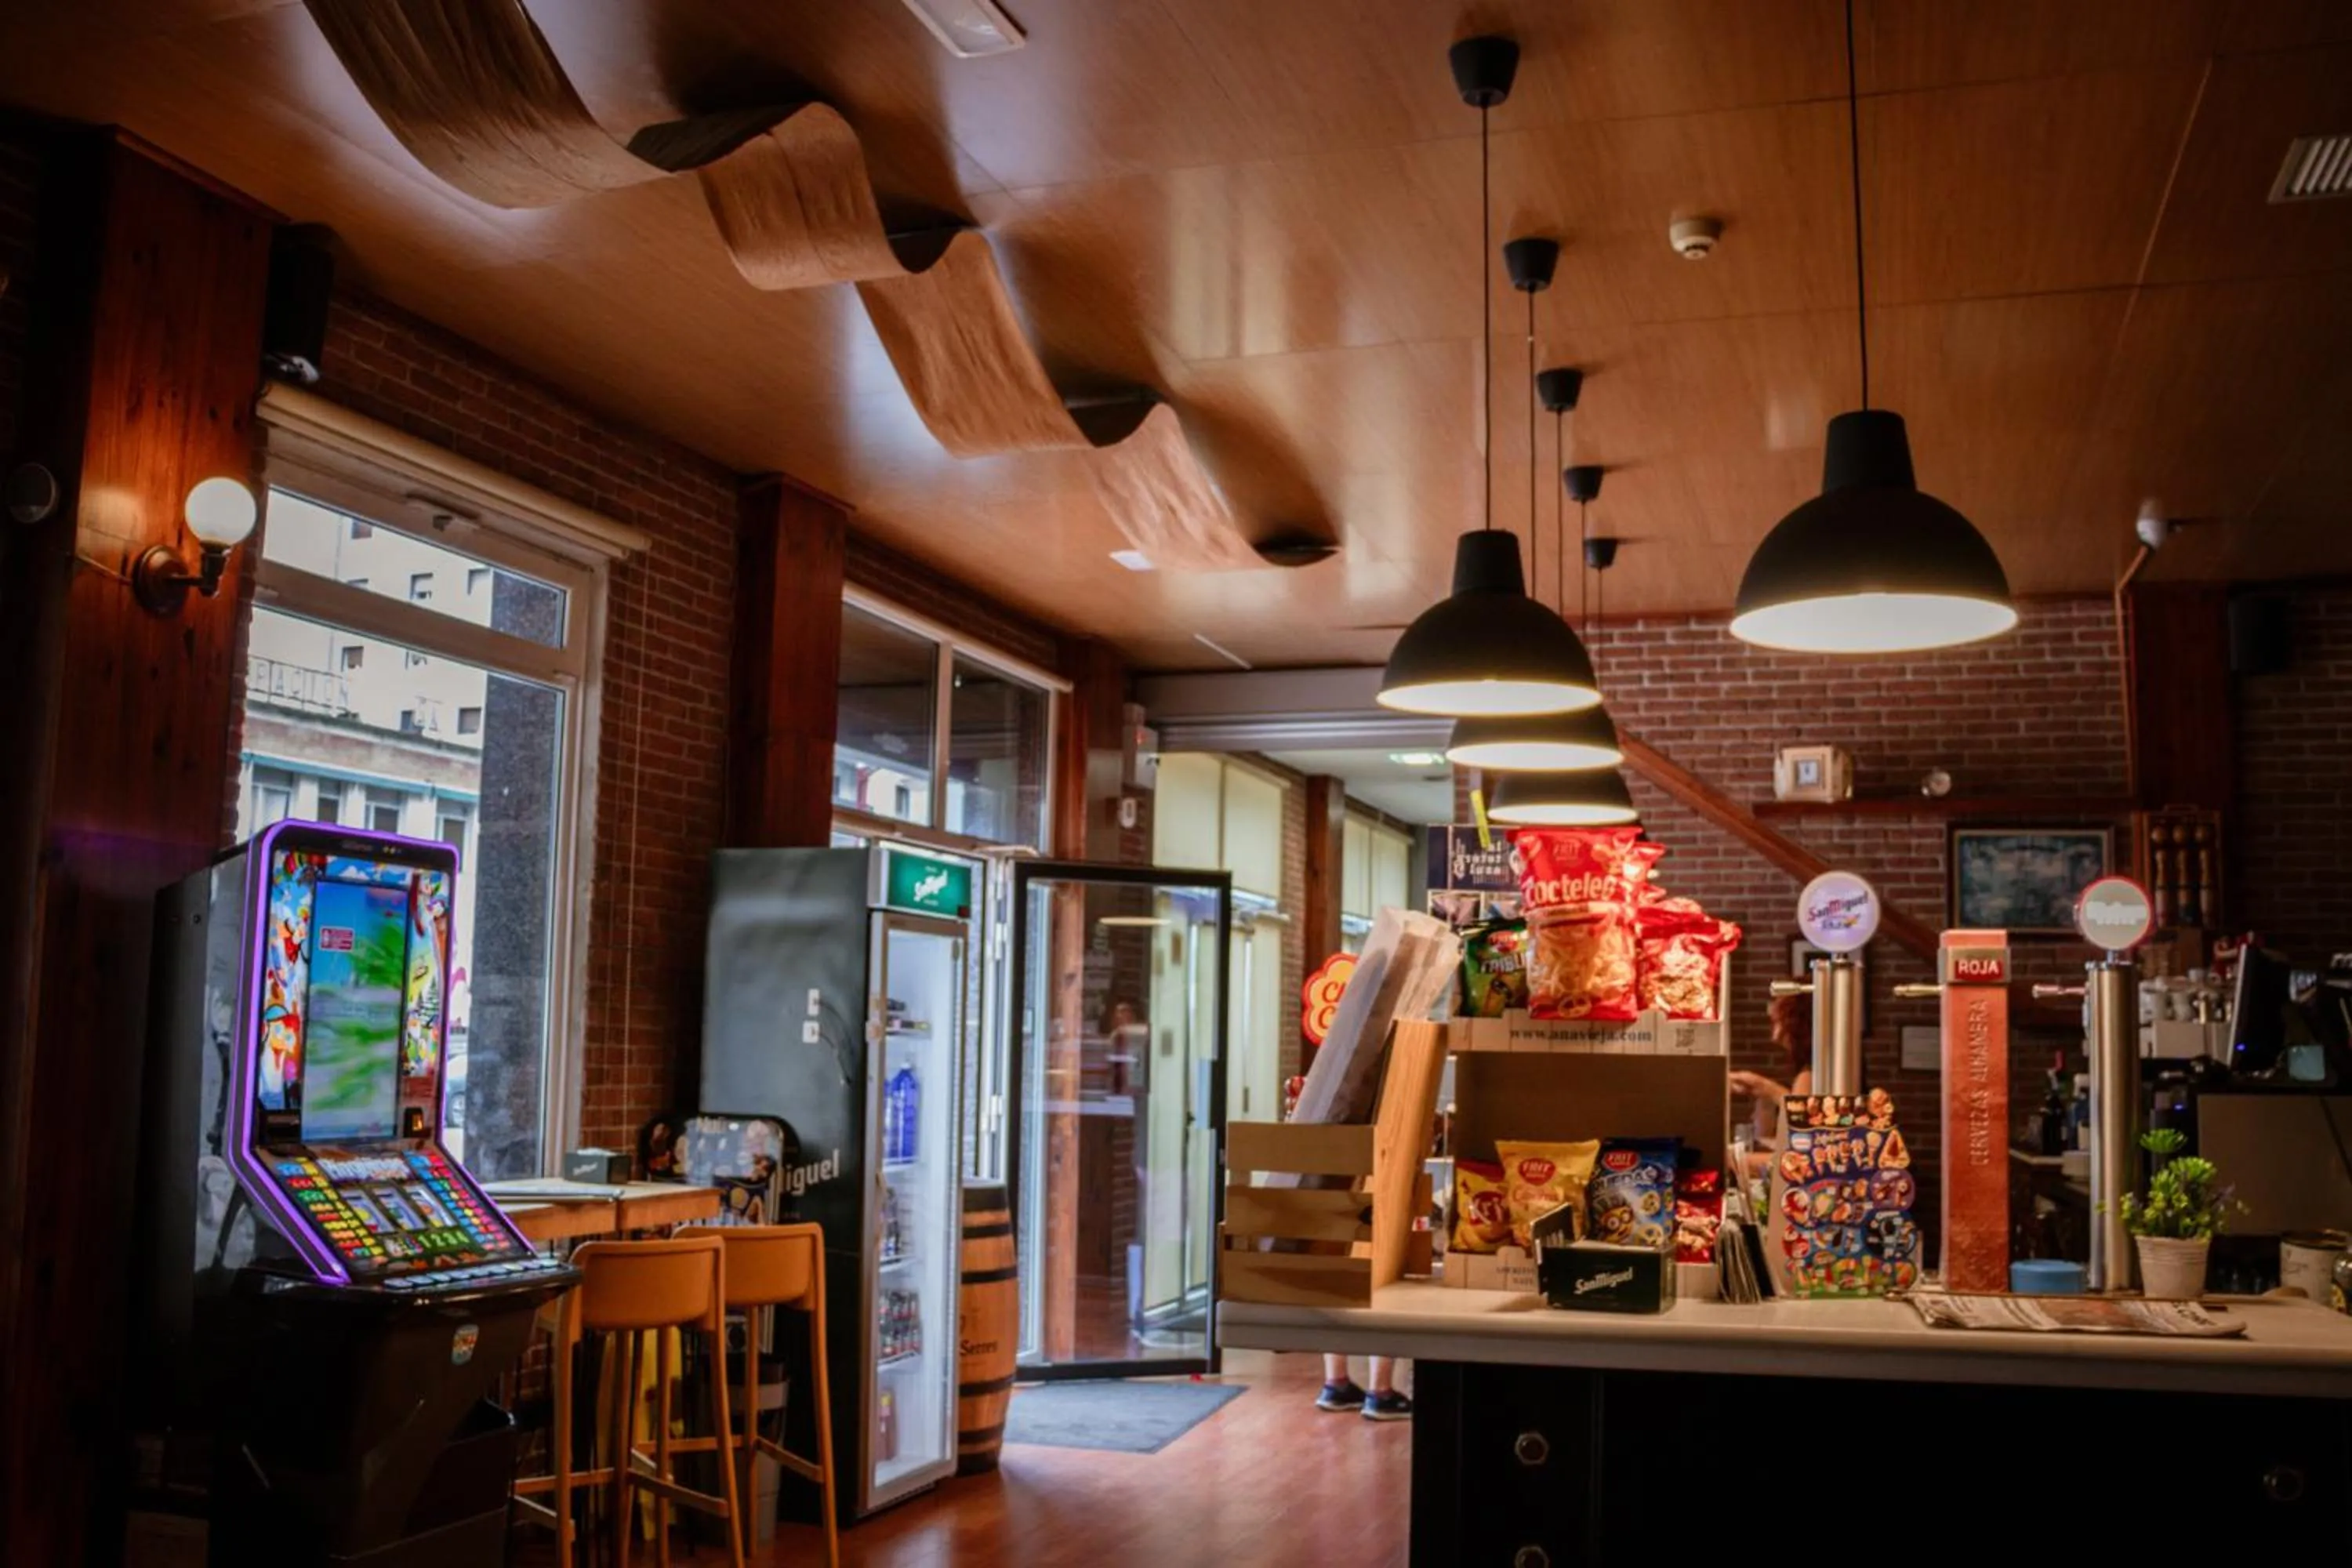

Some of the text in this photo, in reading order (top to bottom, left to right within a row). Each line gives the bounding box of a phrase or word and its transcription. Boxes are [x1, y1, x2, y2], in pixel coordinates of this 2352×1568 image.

[1958, 960, 1999, 975] ROJA
[1969, 1090, 1990, 1166] CERVEZAS
[785, 1148, 840, 1197] iguel
